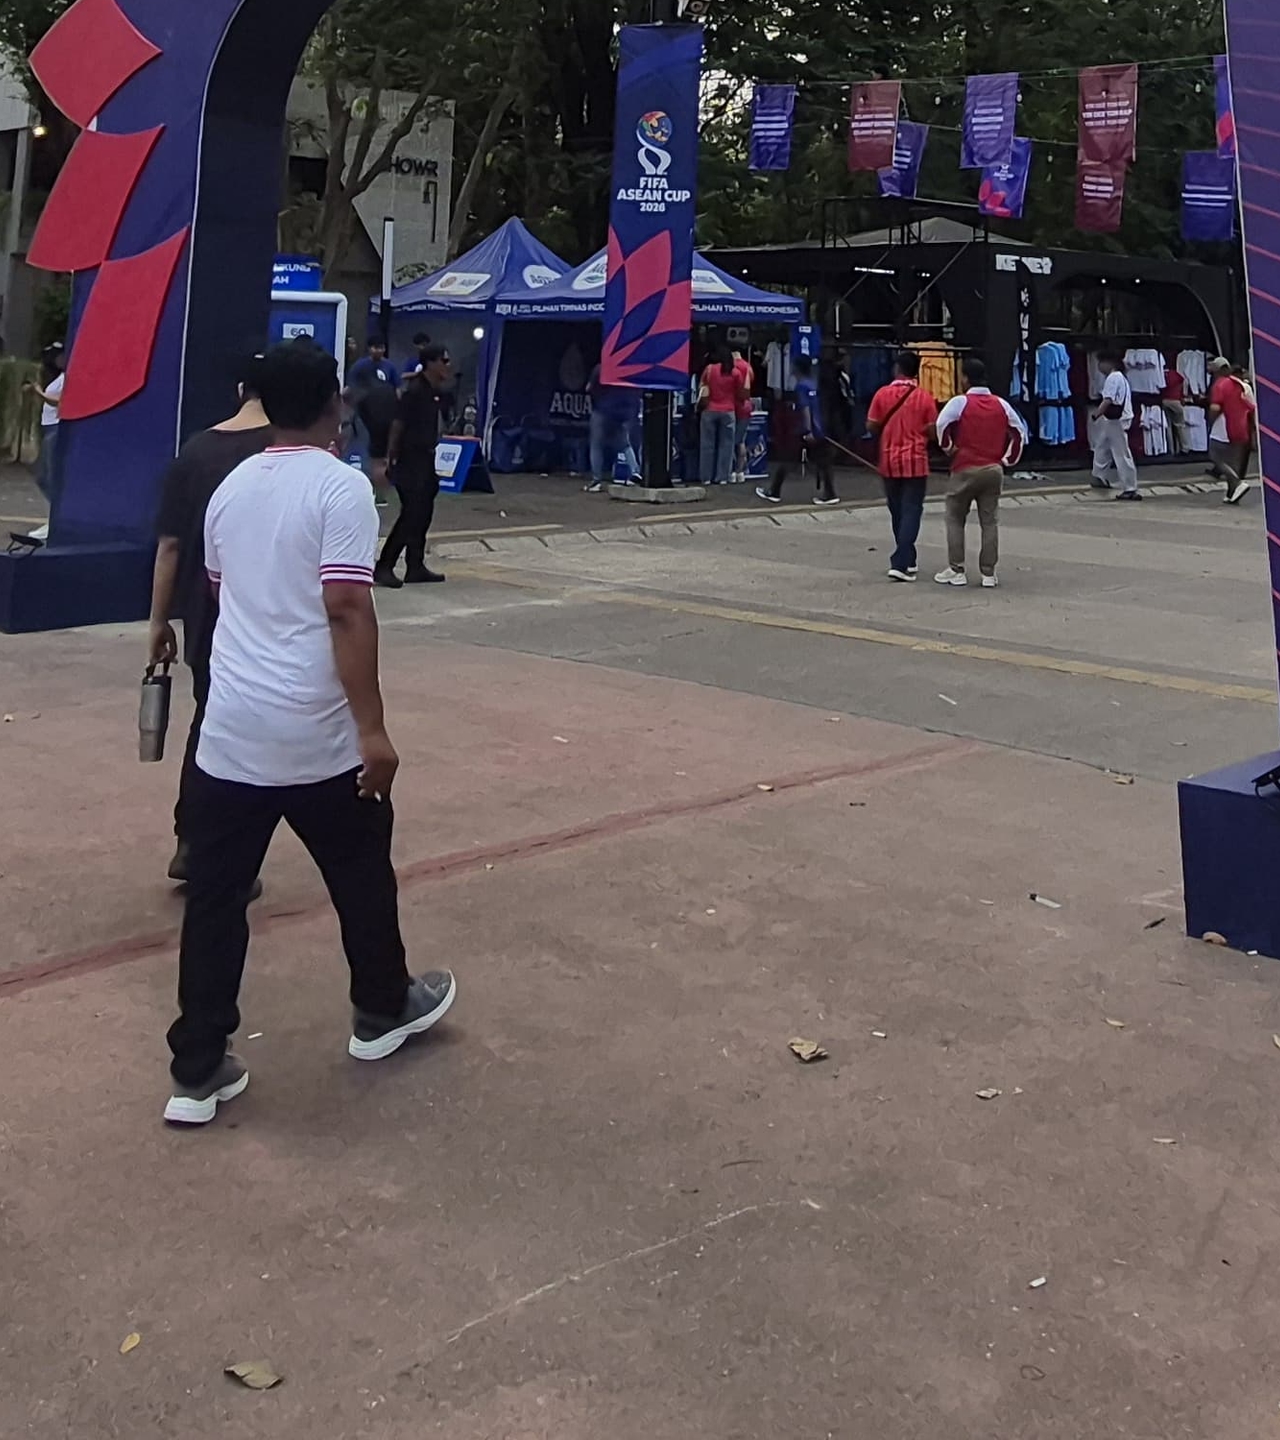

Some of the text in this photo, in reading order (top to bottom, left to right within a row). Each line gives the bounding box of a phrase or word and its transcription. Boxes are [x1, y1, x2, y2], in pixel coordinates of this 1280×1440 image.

[639, 177, 669, 189] FIFA
[617, 188, 691, 202] ASEAN CUP
[640, 202, 666, 212] 2026
[549, 392, 593, 418] AQUA
